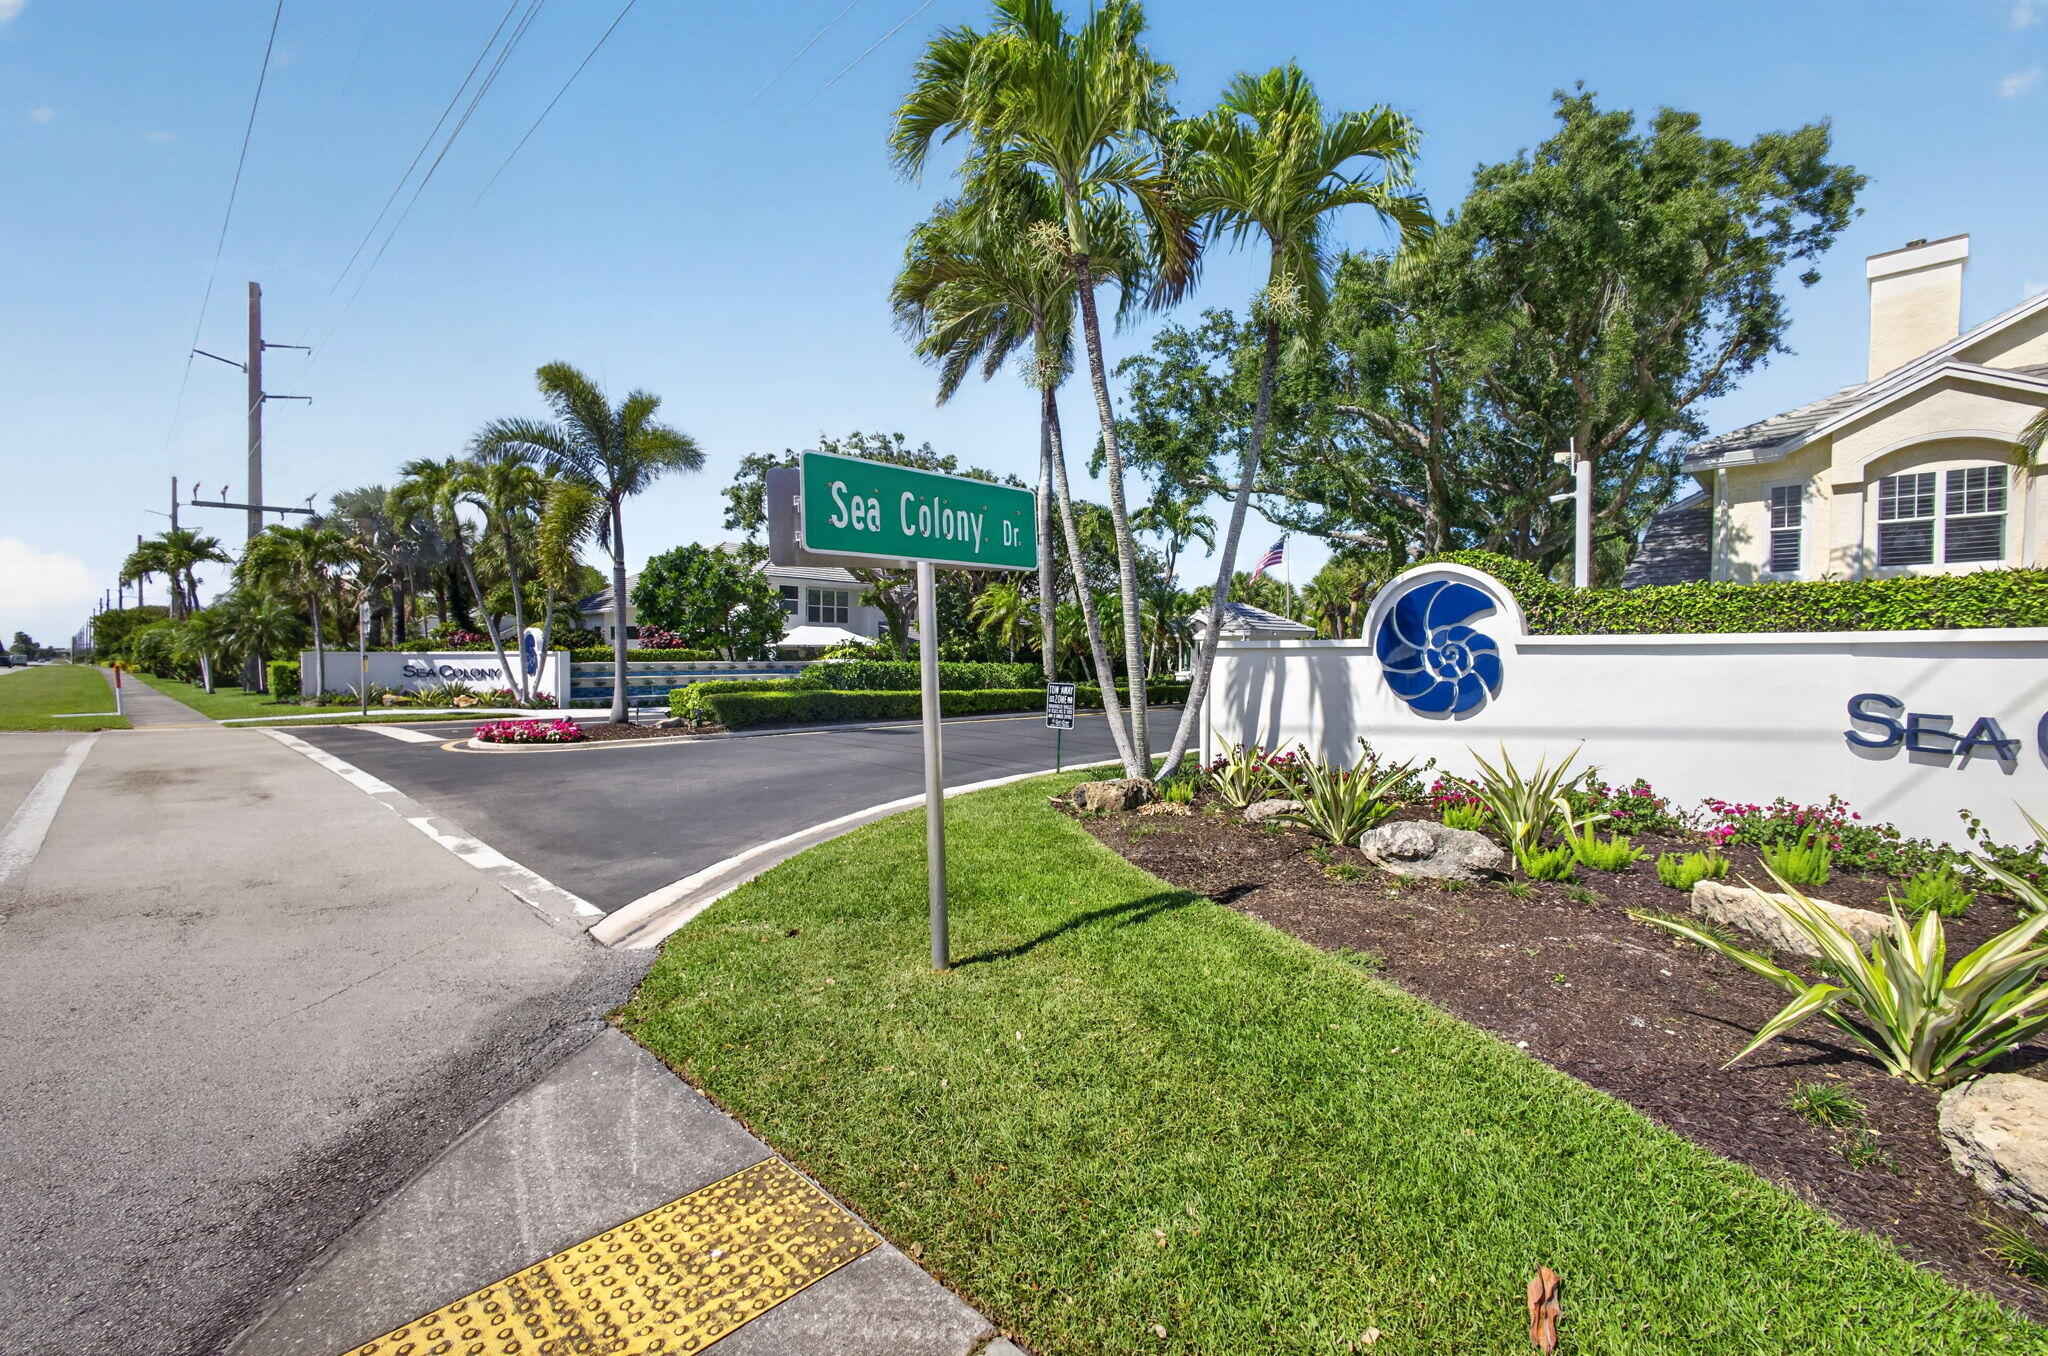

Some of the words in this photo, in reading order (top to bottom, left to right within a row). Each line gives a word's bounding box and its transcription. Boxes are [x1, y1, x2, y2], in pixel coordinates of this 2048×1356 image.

[831, 480, 881, 532] Sea
[900, 491, 984, 554] Colony
[1002, 519, 1020, 548] Dr
[403, 665, 436, 678] SEA
[439, 665, 500, 678] COLONY
[1050, 685, 1059, 694] TOW
[1061, 686, 1073, 695] AWAY
[1054, 695, 1067, 704] ZONE
[1843, 693, 2021, 761] SEA
